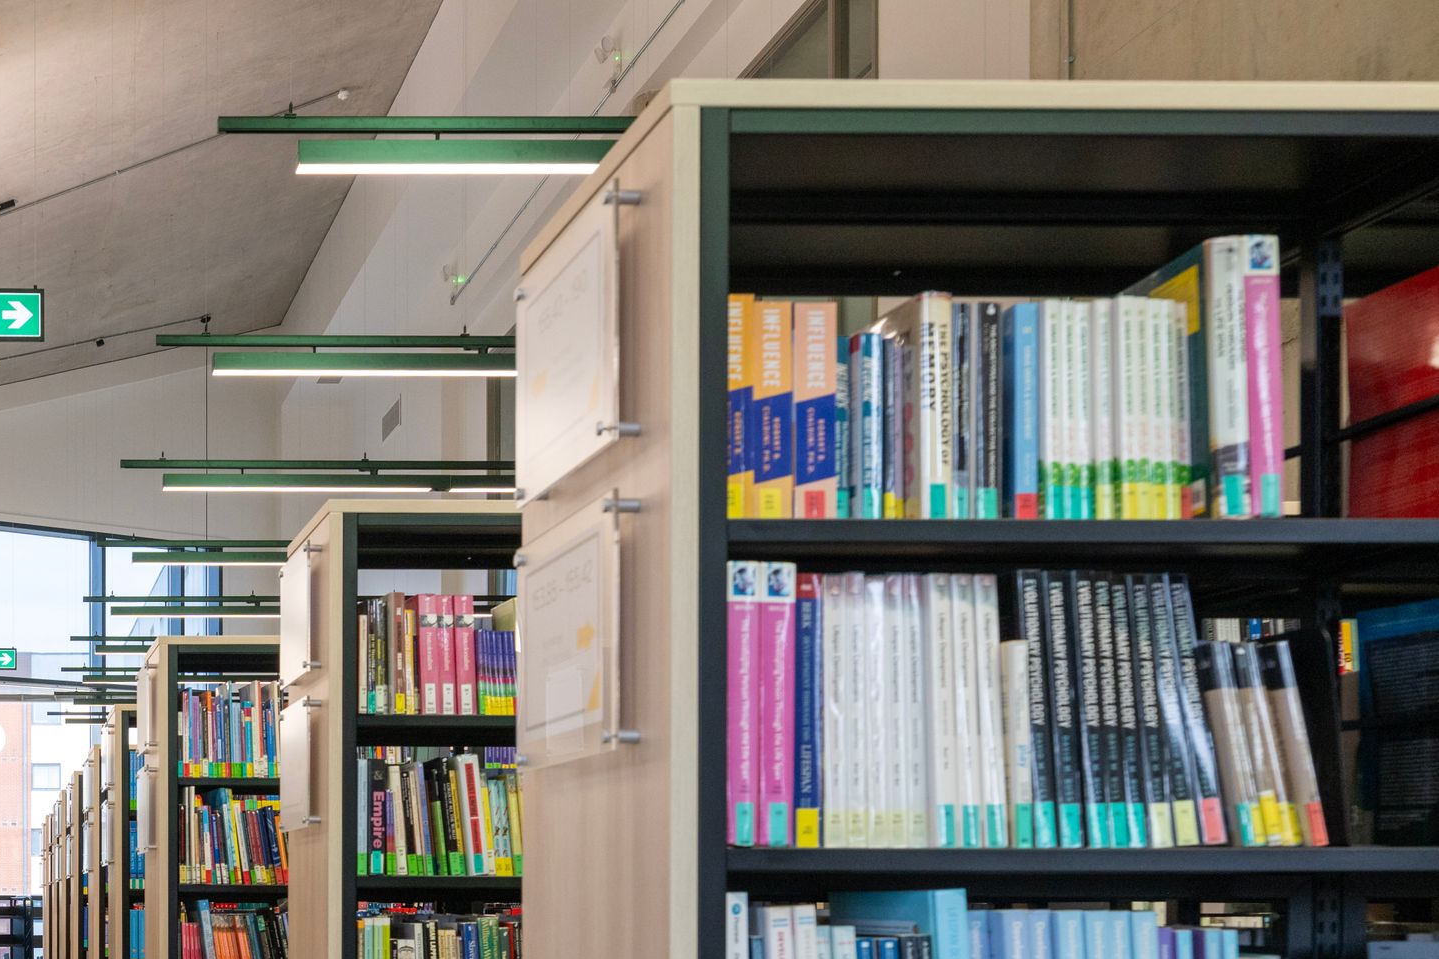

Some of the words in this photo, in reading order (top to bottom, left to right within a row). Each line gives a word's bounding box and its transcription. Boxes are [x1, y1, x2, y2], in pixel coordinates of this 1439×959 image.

[762, 309, 781, 387] INFLUENCE
[806, 310, 825, 389] INFLUENCE
[921, 322, 936, 412] MEMORY
[939, 323, 948, 346] THE
[939, 352, 951, 445] PSYCHOLOGY
[941, 450, 950, 466] OF
[801, 602, 812, 628] BERK
[1024, 579, 1041, 656] EVOLUTIONARY
[1049, 581, 1068, 658] EVOLUTIONARY
[1077, 580, 1094, 657] EVOLUTIONARY
[1095, 581, 1113, 657] EVOLUTIONARY
[1112, 585, 1131, 659] EVOLUTIONARY
[1133, 584, 1152, 659] EVOLUTIONARY
[1152, 583, 1170, 658] EVOLUTIONARY
[1170, 583, 1190, 657] EVOLUTIONARY
[1183, 659, 1204, 725] PSYCHOLOGY
[1029, 659, 1045, 726] PSYCHOLOGY
[1054, 660, 1072, 728] PSYCHOLOGY
[1082, 659, 1099, 727] PSYCHOLOGY
[1100, 660, 1117, 727] PSYCHOLOGY
[1118, 661, 1135, 729] PSYCHOLOGY
[1140, 661, 1158, 728] PSYCHOLOGY
[1159, 660, 1177, 725] PSYCHOLOGY
[800, 745, 812, 793] LIFESPAN
[371, 791, 384, 848] Empire
[481, 919, 491, 950] William
